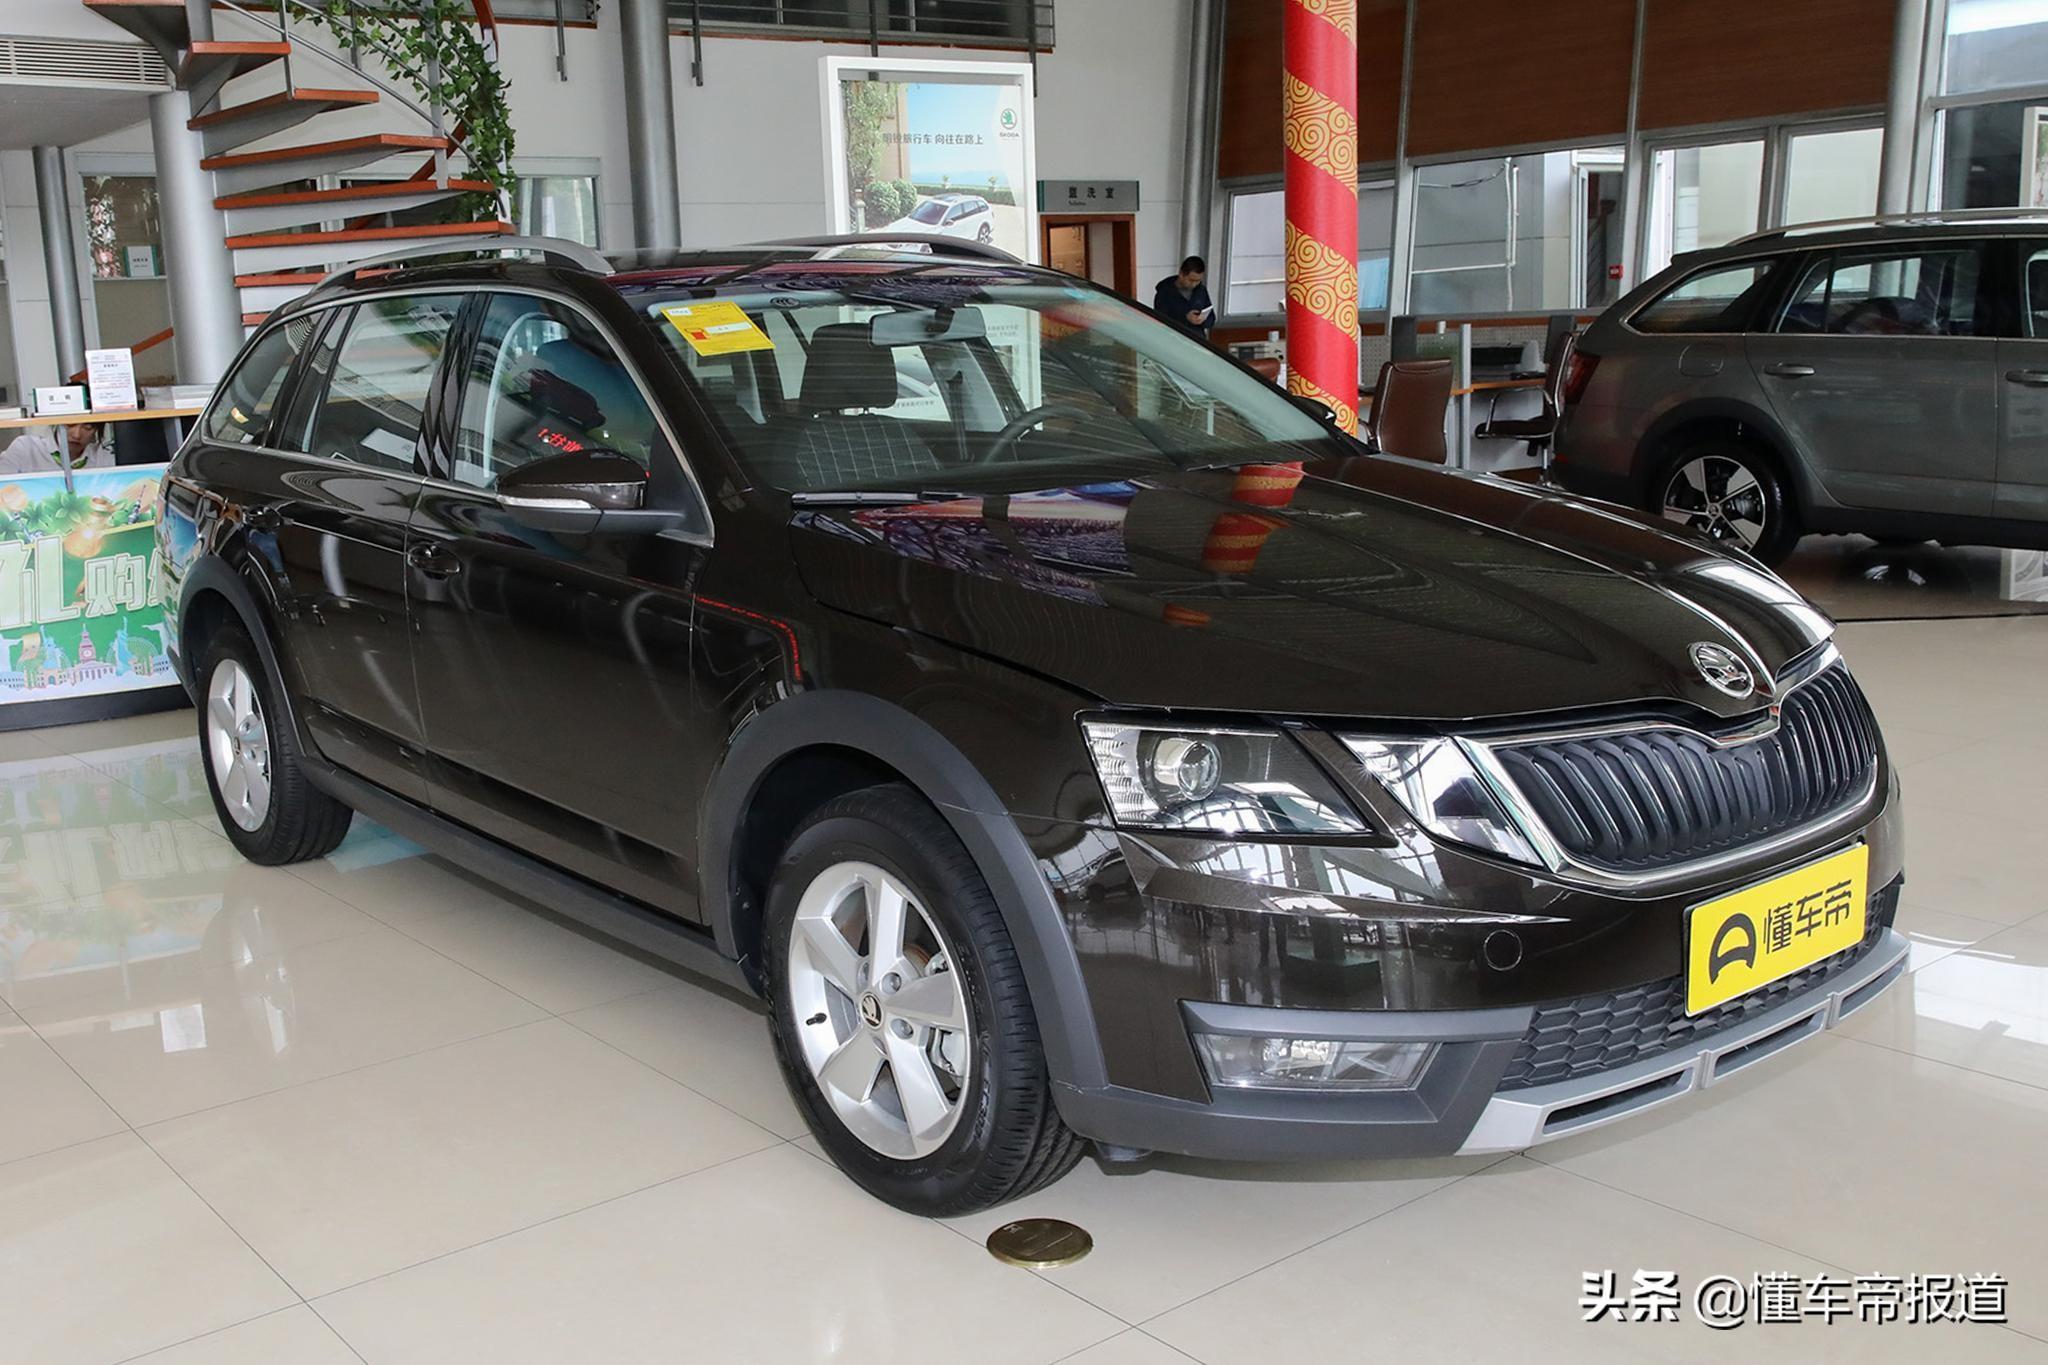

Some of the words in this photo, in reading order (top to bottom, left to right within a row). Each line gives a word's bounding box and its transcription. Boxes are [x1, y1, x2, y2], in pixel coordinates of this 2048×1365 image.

[934, 133, 984, 145] 向往在路上
[1763, 879, 1852, 955] 懂车帝
